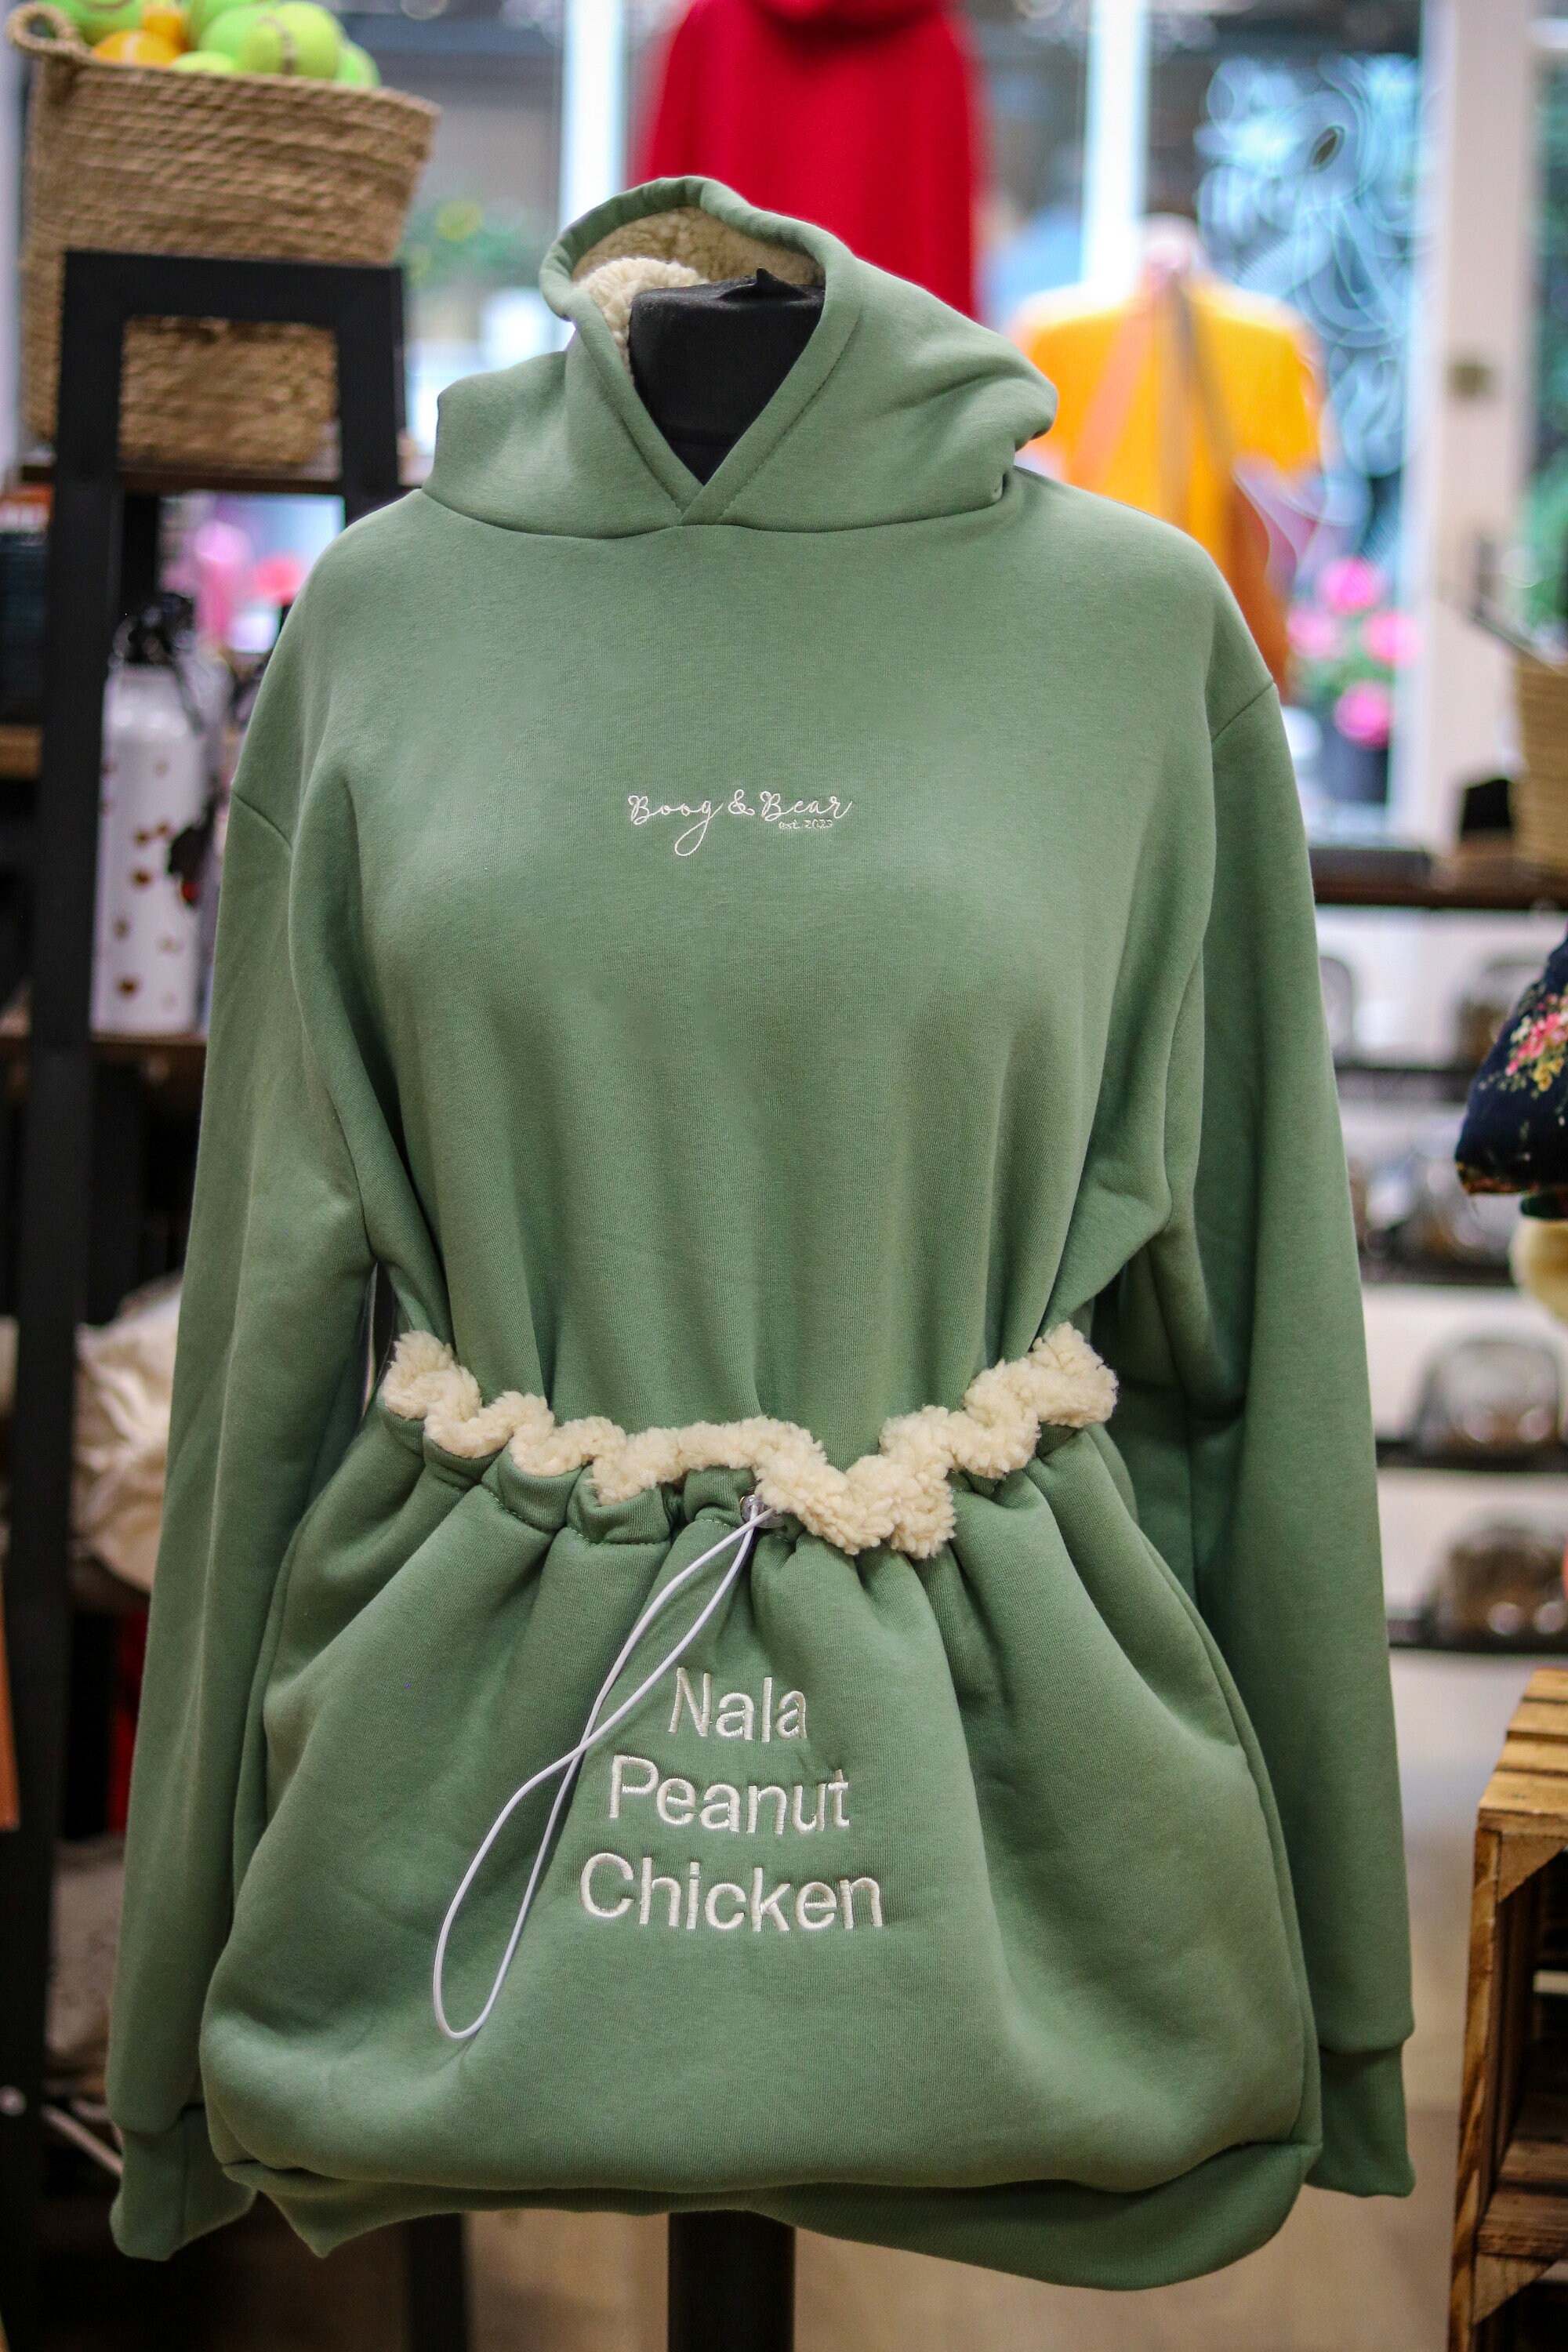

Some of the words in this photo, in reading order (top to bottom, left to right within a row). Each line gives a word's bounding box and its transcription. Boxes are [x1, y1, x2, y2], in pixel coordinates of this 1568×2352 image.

[628, 795, 723, 856] Boog
[728, 789, 755, 815] &
[760, 790, 853, 821] Bear
[669, 1668, 807, 1742] Nala
[609, 1755, 850, 1835] Peanut
[580, 1853, 884, 1932] Chicken
